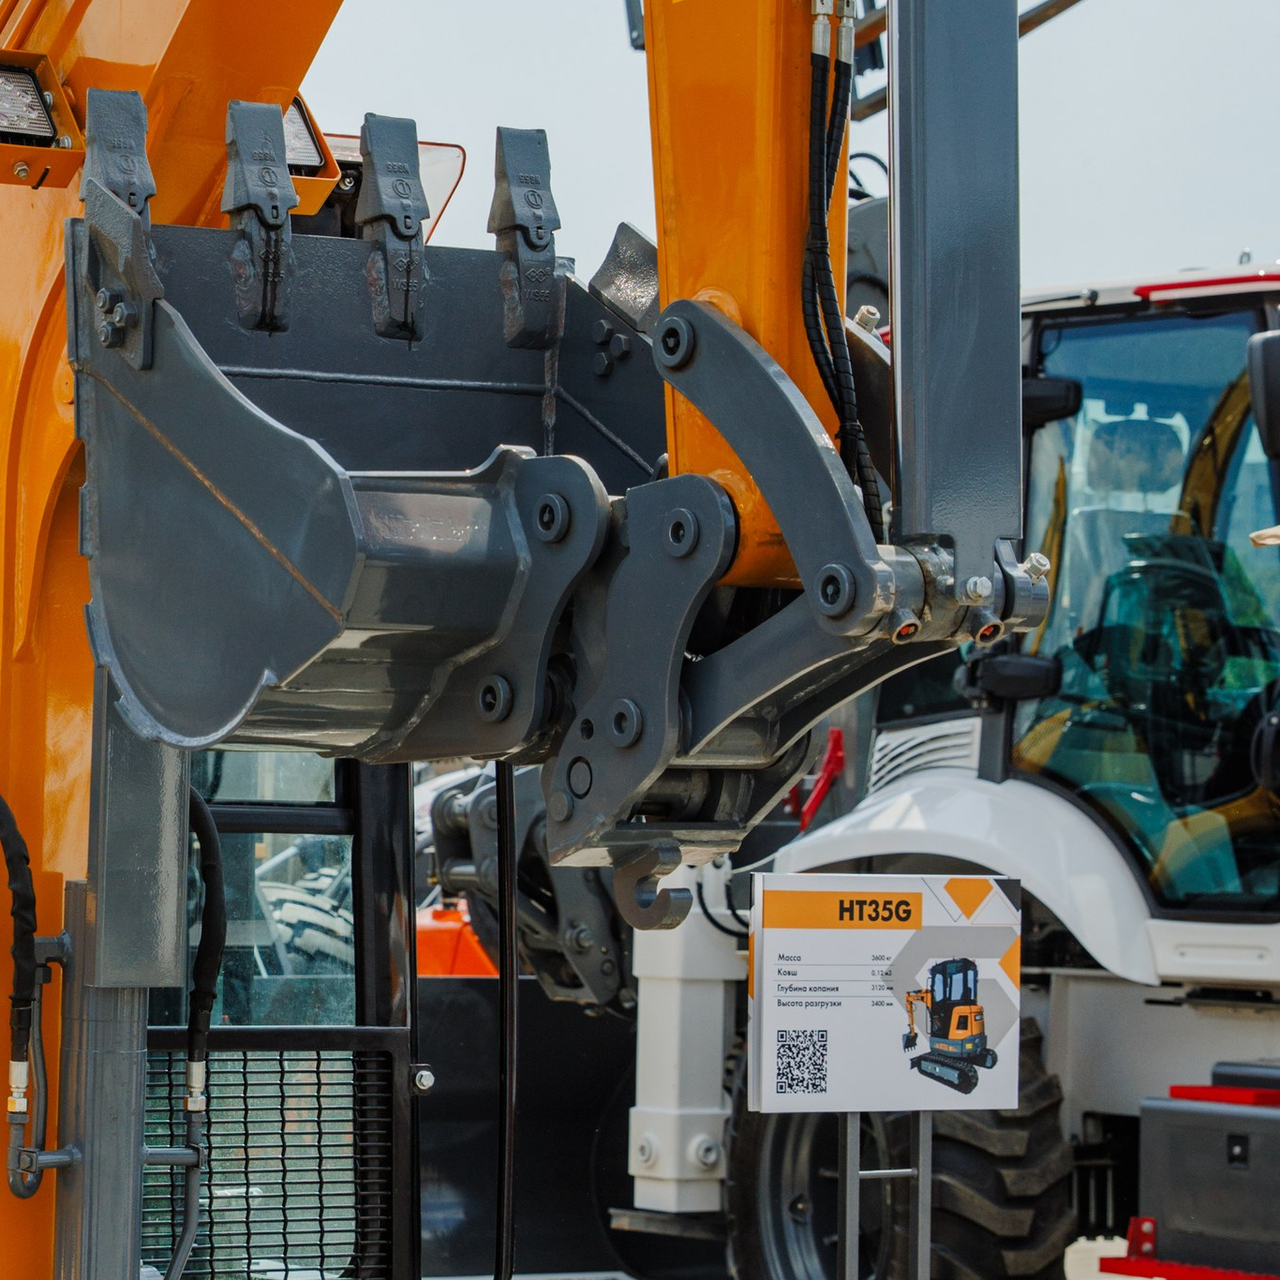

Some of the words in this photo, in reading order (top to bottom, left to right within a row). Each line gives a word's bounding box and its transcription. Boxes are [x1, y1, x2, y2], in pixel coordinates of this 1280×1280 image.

[838, 899, 912, 922] HT35G
[778, 954, 801, 962] Масса
[777, 968, 798, 976] Ковш
[777, 984, 807, 994] Глубина
[777, 999, 803, 1007] Высота
[805, 1000, 842, 1009] разгрузки
